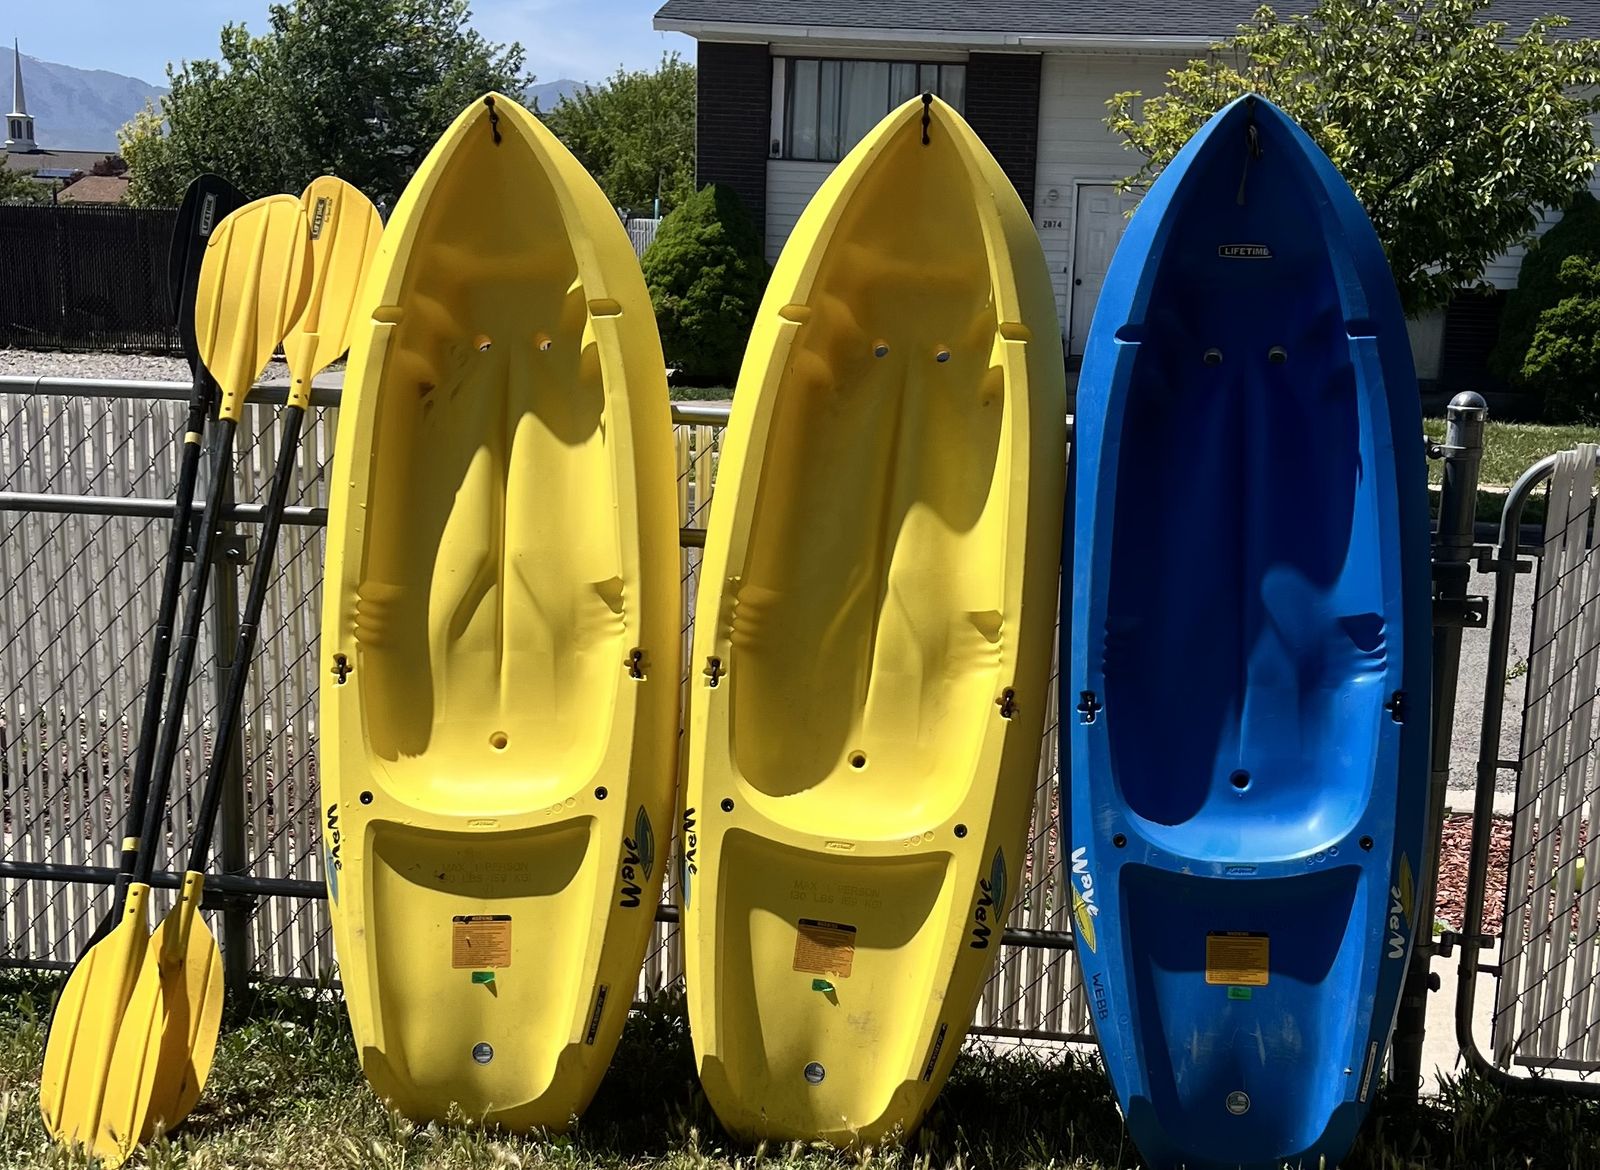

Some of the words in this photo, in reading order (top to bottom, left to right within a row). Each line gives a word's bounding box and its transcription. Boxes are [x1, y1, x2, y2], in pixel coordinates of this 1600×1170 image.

[327, 803, 342, 871] Wave
[620, 836, 641, 908] Wave
[683, 807, 698, 875] Wave
[970, 878, 993, 949] Wave
[1071, 846, 1099, 917] Wave
[1388, 886, 1405, 959] Wave
[1092, 972, 1109, 1021] WEBB
